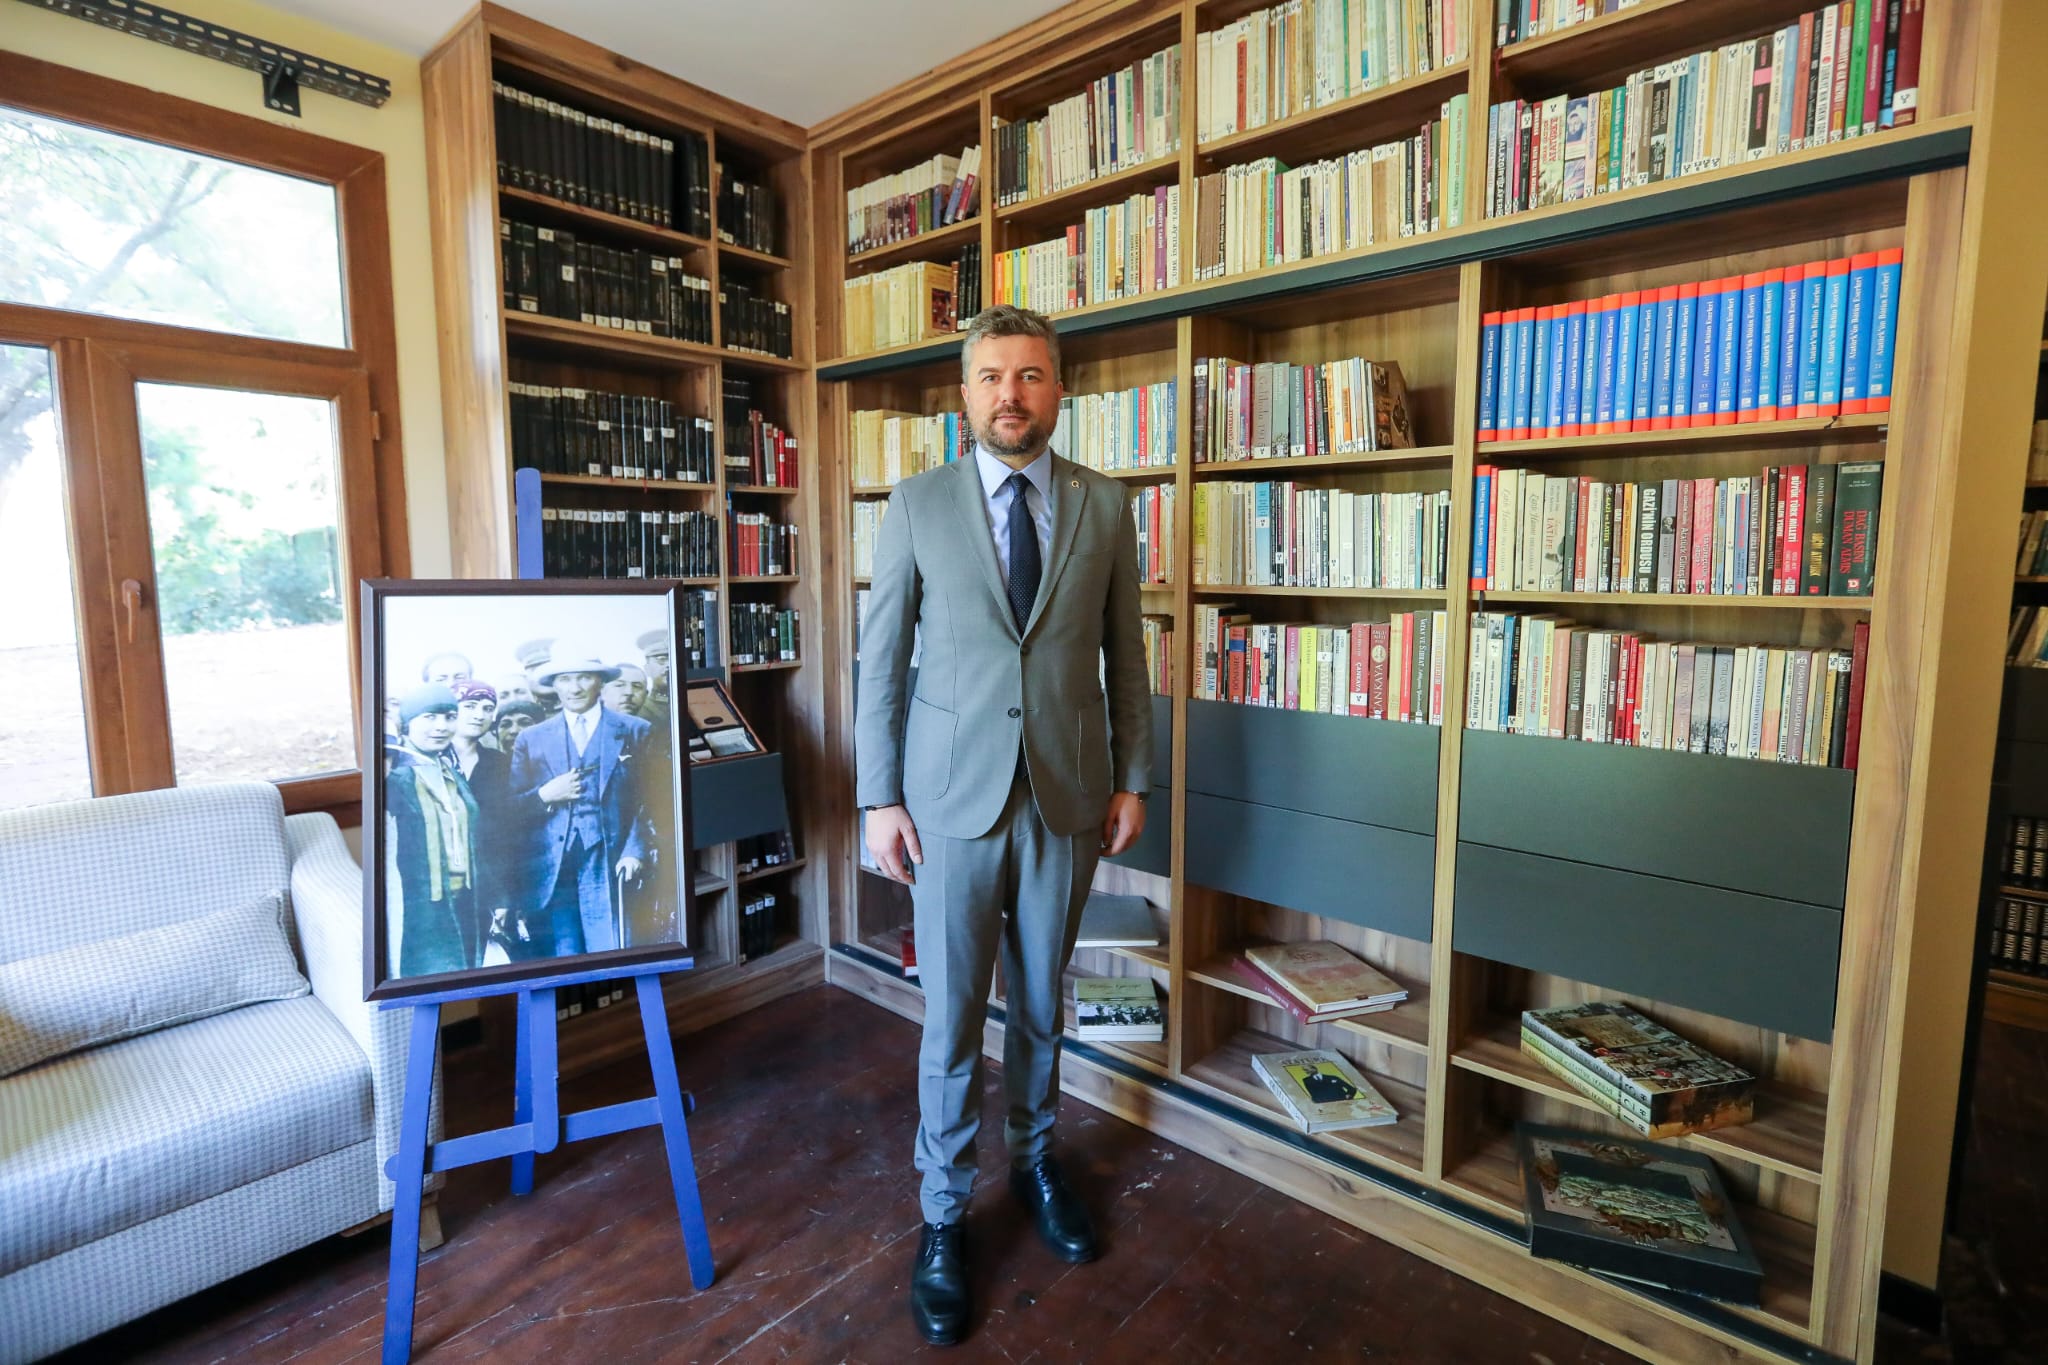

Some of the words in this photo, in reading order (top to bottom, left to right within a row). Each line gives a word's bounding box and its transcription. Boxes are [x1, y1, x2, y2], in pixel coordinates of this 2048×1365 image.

[1852, 277, 1862, 302] Eserleri
[1880, 273, 1890, 298] Eserleri
[1850, 303, 1860, 324] Bütün
[1878, 300, 1888, 320] Bütün
[1849, 325, 1858, 359] Atatürk'ün
[1876, 321, 1886, 356] Atatürk'ün
[1791, 476, 1800, 497] BÜYÜK
[1641, 488, 1657, 530] GAZİ'NİN
[1790, 500, 1798, 516] TÜRK
[1856, 510, 1867, 530] DAĞ
[1788, 518, 1798, 542] MİLLETİ
[1638, 532, 1652, 573] ORDUSU
[1207, 670, 1215, 691] ADAM
[2013, 849, 2026, 875] NUTUK
[2032, 851, 2045, 878] NUTUK
[2003, 934, 2015, 959] NUTUK
[2021, 936, 2033, 961] NUTUK
